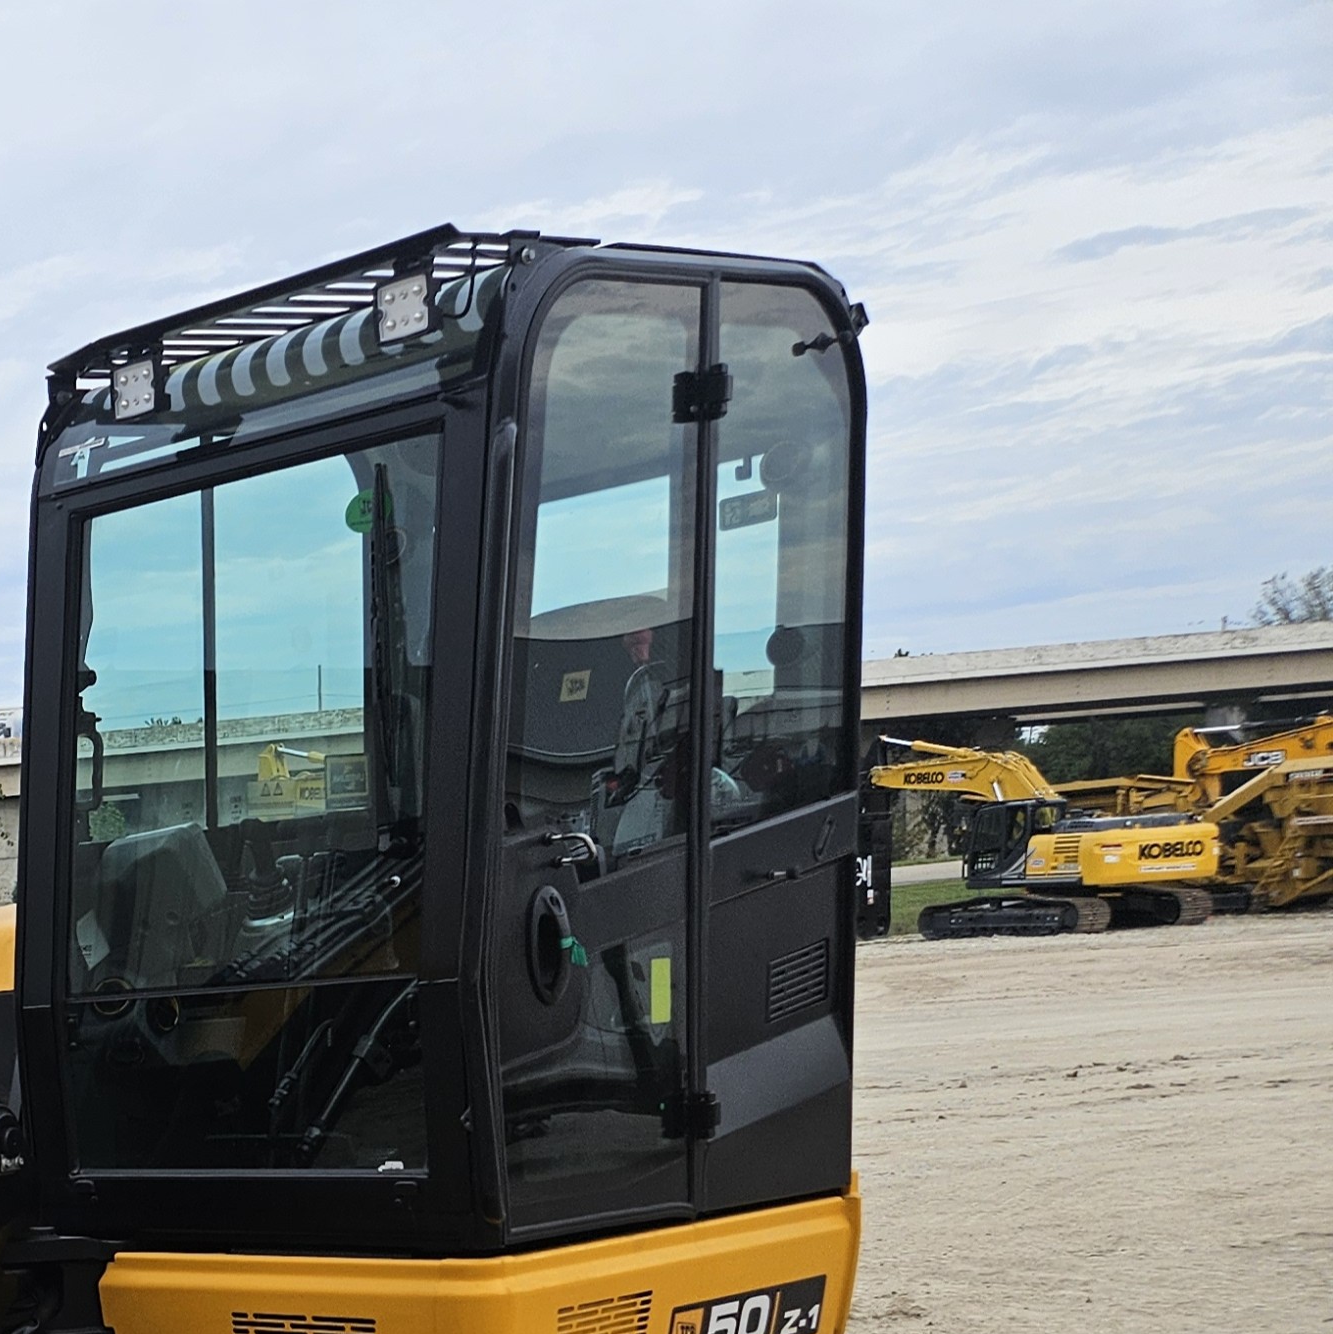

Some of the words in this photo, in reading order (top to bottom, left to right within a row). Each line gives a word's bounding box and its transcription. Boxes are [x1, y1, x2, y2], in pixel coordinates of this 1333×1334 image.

[1243, 751, 1286, 767] JCB
[903, 771, 945, 785] KOBELCO
[1138, 840, 1204, 861] KOBELCO
